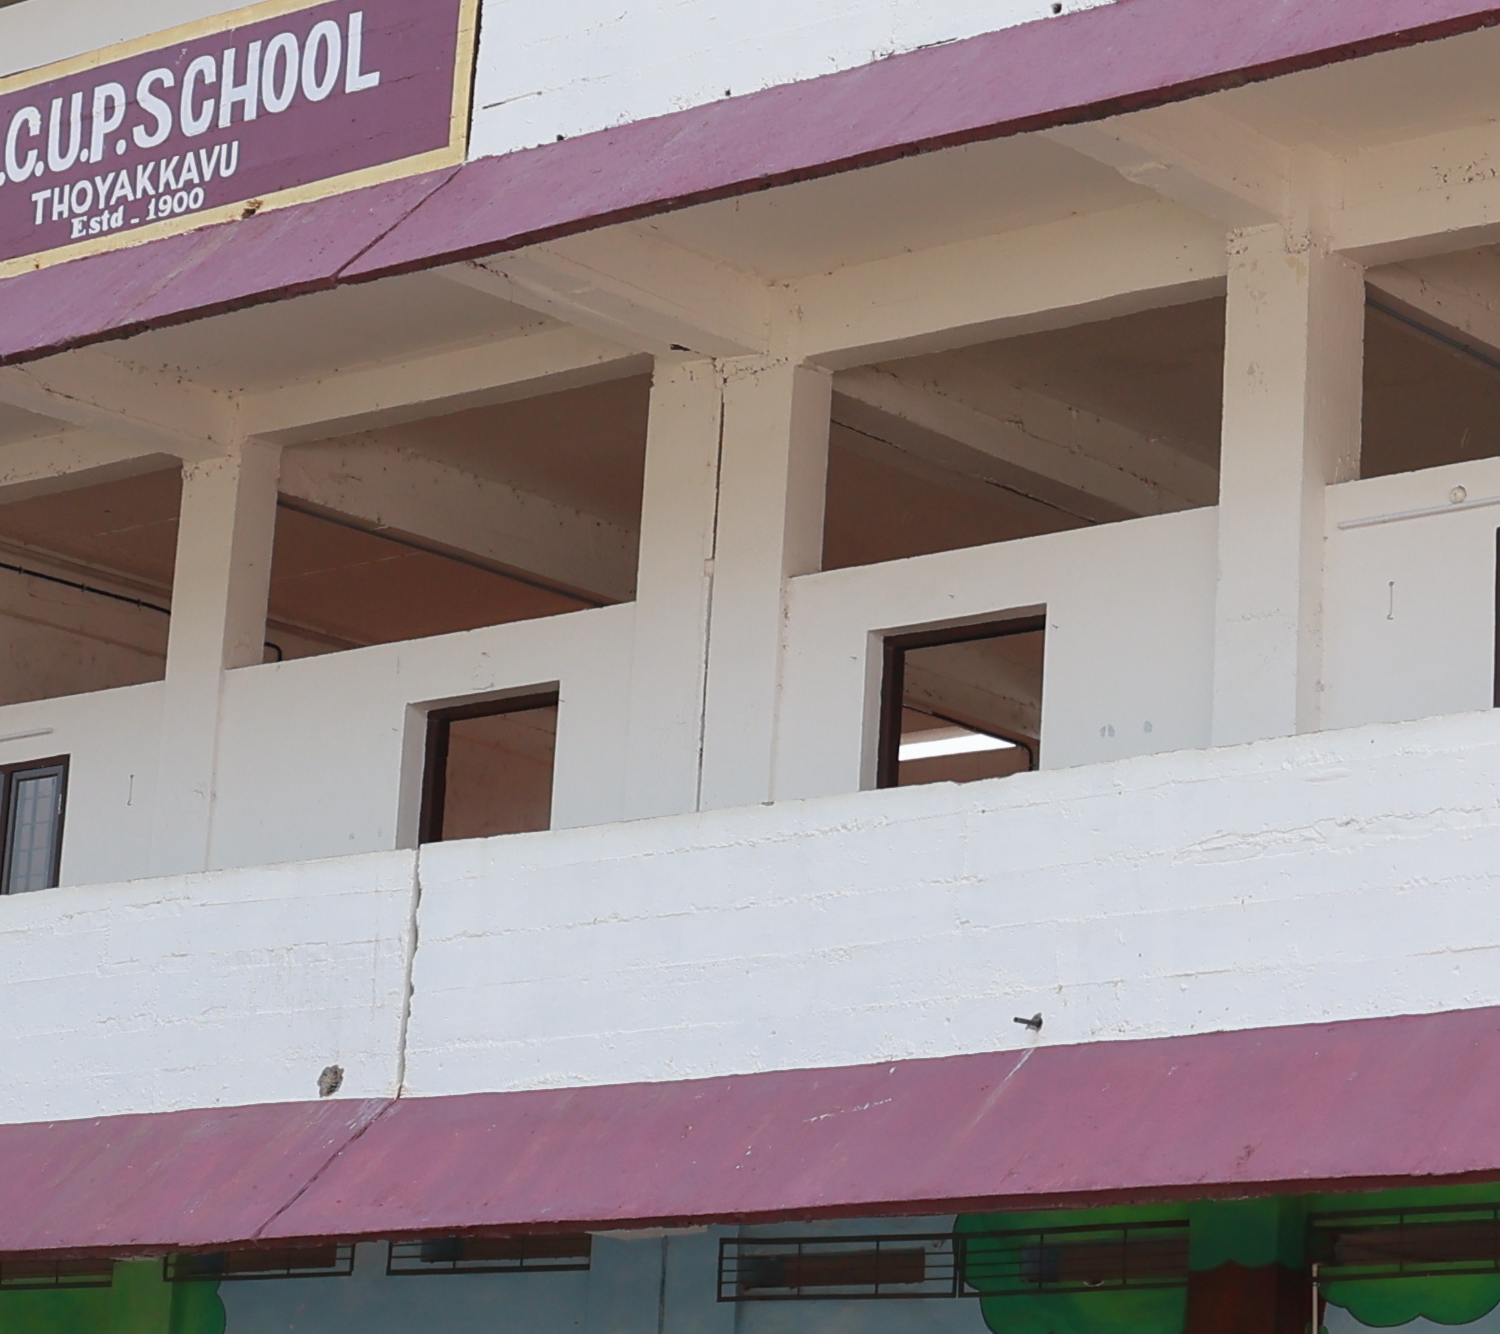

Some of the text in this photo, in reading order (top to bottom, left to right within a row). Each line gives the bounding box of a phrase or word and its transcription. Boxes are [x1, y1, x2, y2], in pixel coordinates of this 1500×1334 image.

[31, 140, 239, 226] THOYAKKAVU
[70, 204, 124, 240] Estd
[147, 187, 205, 224] 1900
